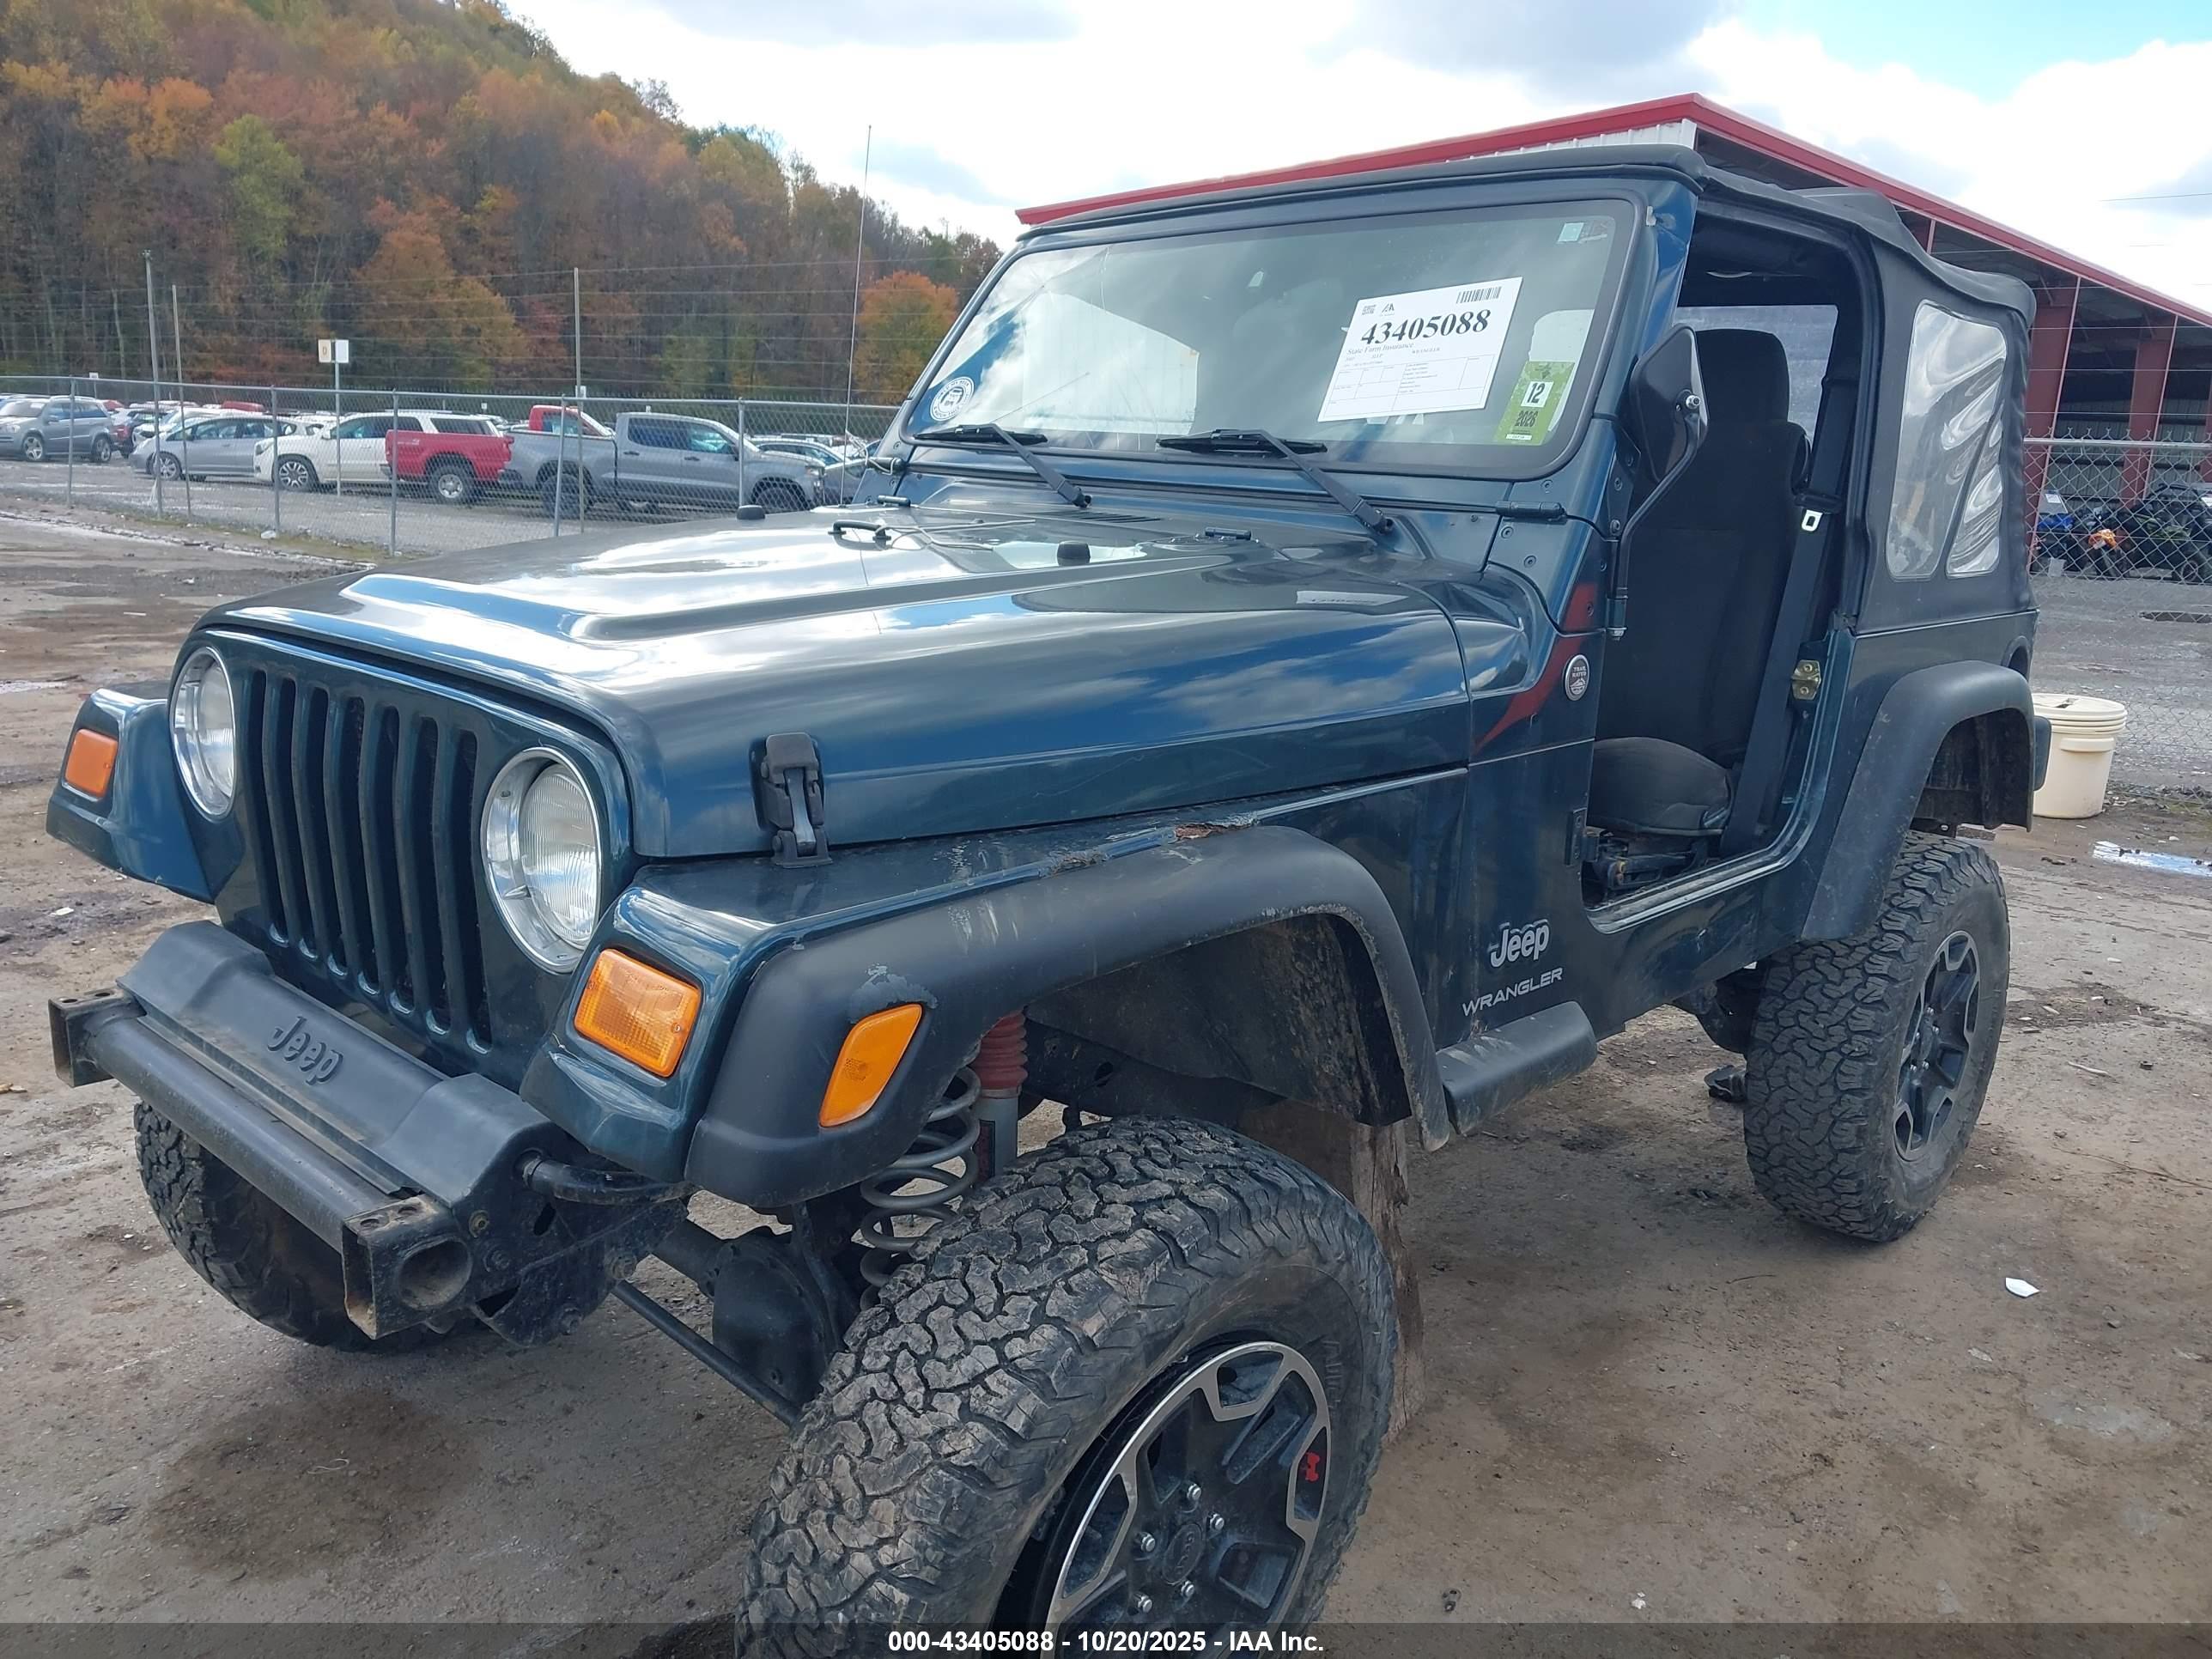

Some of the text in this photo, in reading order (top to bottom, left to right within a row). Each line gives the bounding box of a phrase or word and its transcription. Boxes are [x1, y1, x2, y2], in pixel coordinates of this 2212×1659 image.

[1360, 309, 1492, 344] 43405088
[1346, 347, 1364, 356] State
[1364, 345, 1382, 354] Farm
[1526, 382, 1546, 404] 12
[1490, 924, 1550, 968] Jeep
[1462, 967, 1563, 1017] WRANGLER
[267, 1016, 343, 1086] Jeep
